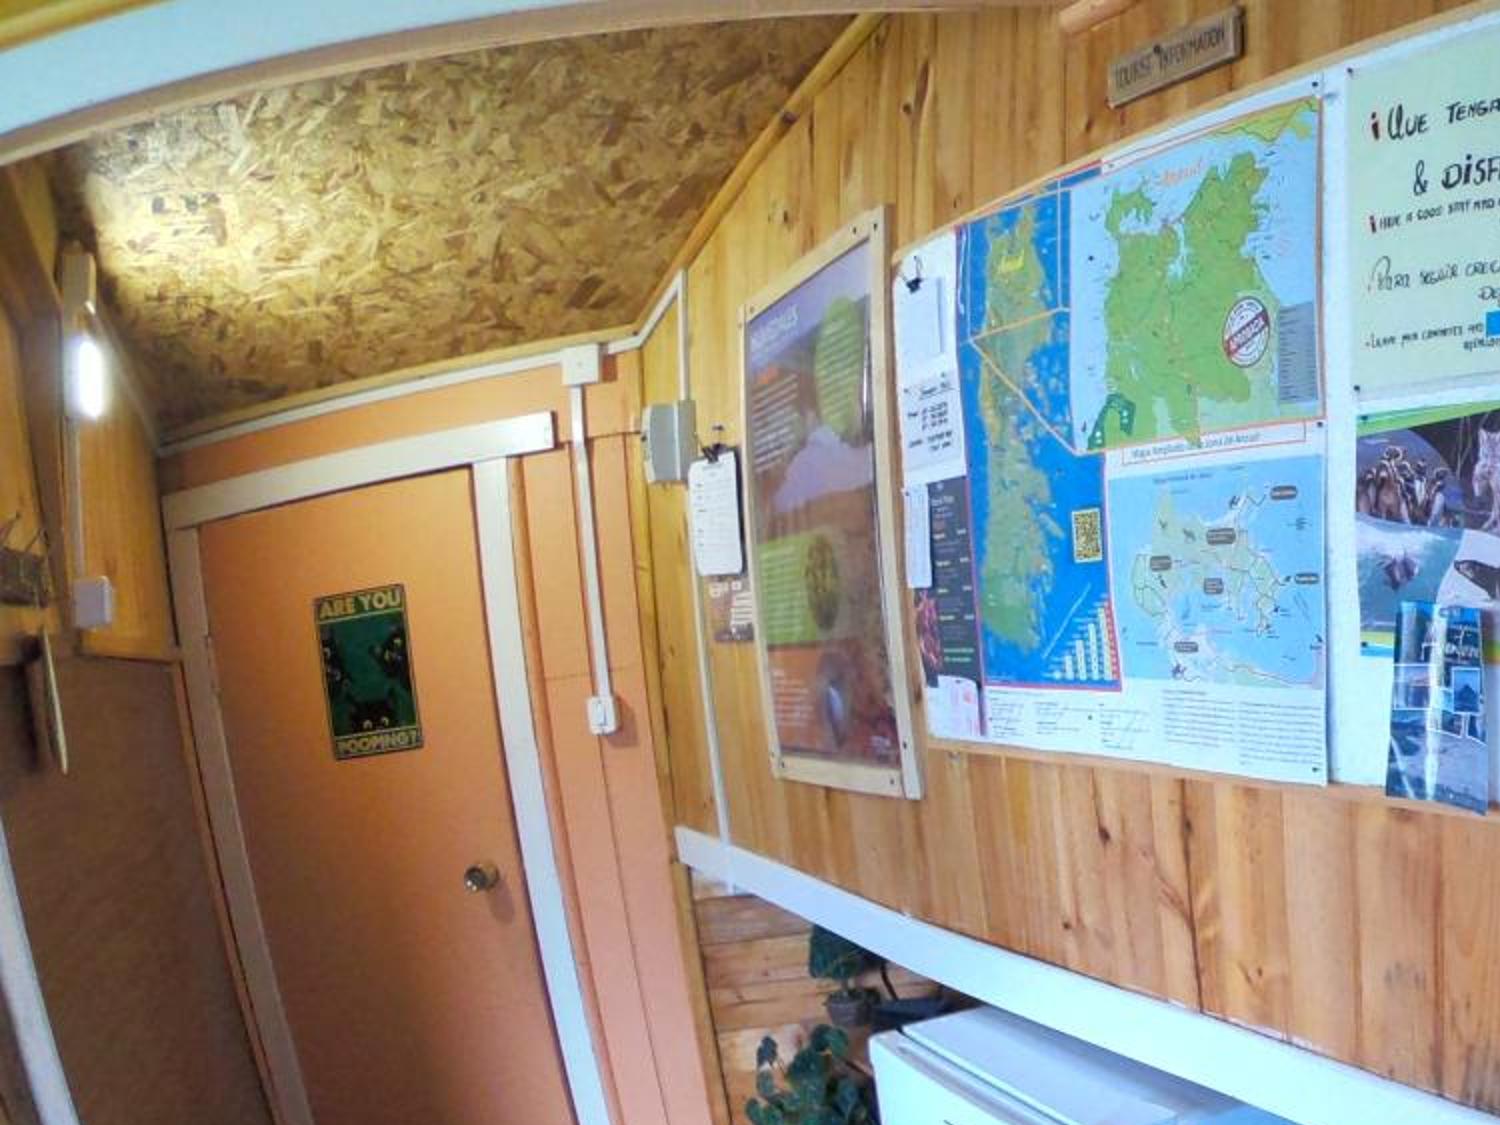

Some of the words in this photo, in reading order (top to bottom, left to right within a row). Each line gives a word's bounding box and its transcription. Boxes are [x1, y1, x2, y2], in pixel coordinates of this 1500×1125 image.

[1412, 159, 1429, 197] &
[319, 597, 355, 621] ARE
[357, 589, 401, 611] YOU
